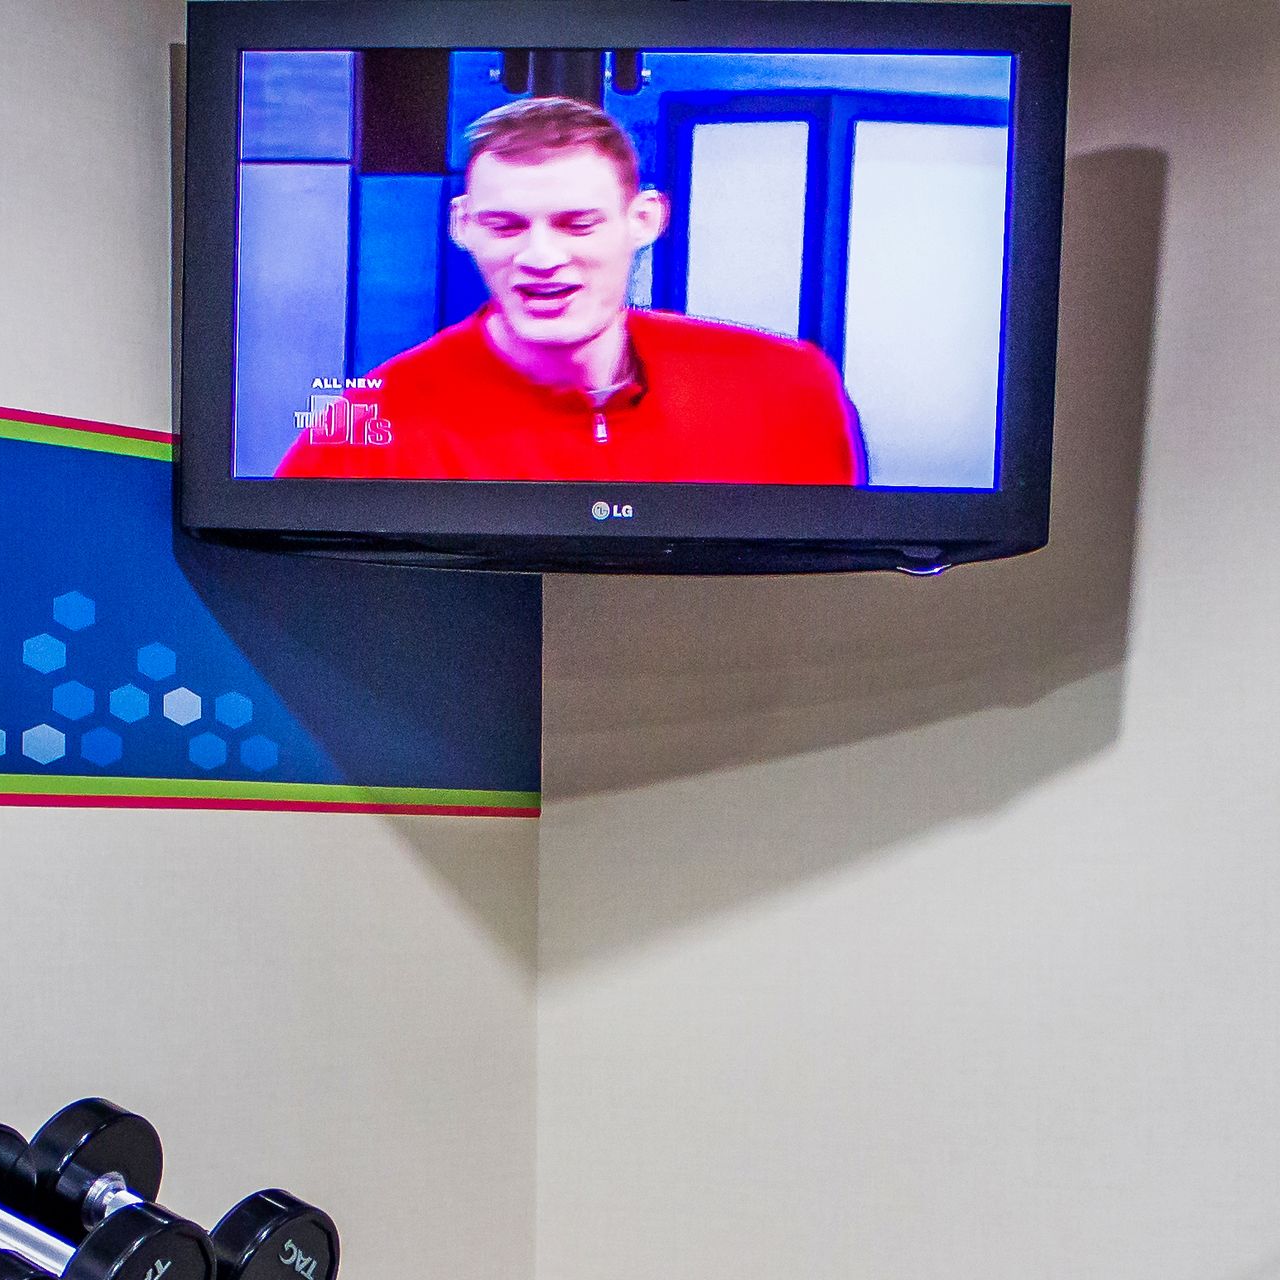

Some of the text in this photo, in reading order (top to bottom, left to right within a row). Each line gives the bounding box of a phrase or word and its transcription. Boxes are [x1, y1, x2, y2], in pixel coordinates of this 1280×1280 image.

[312, 378, 382, 388] ALL NEW
[613, 505, 633, 517] LG
